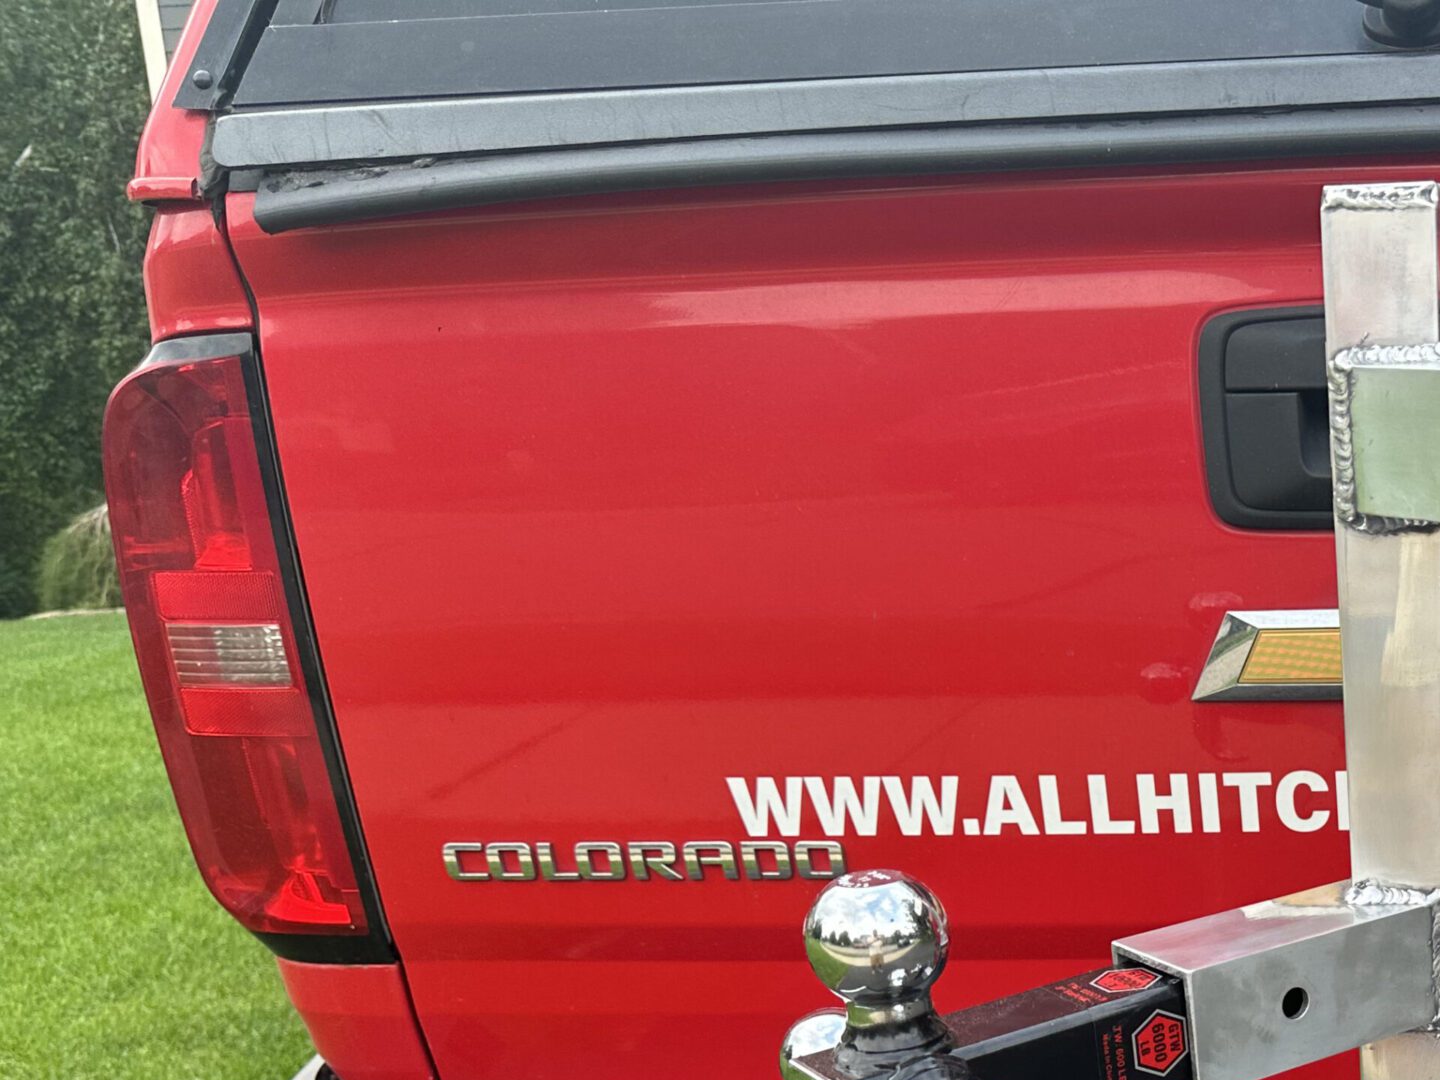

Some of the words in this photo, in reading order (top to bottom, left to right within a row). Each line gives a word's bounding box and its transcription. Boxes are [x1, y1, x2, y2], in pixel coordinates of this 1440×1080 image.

[442, 841, 848, 882] COLORADO
[1139, 1040, 1151, 1056] LB
[1151, 1022, 1168, 1063] 6000
[1168, 1023, 1181, 1052] GTW
